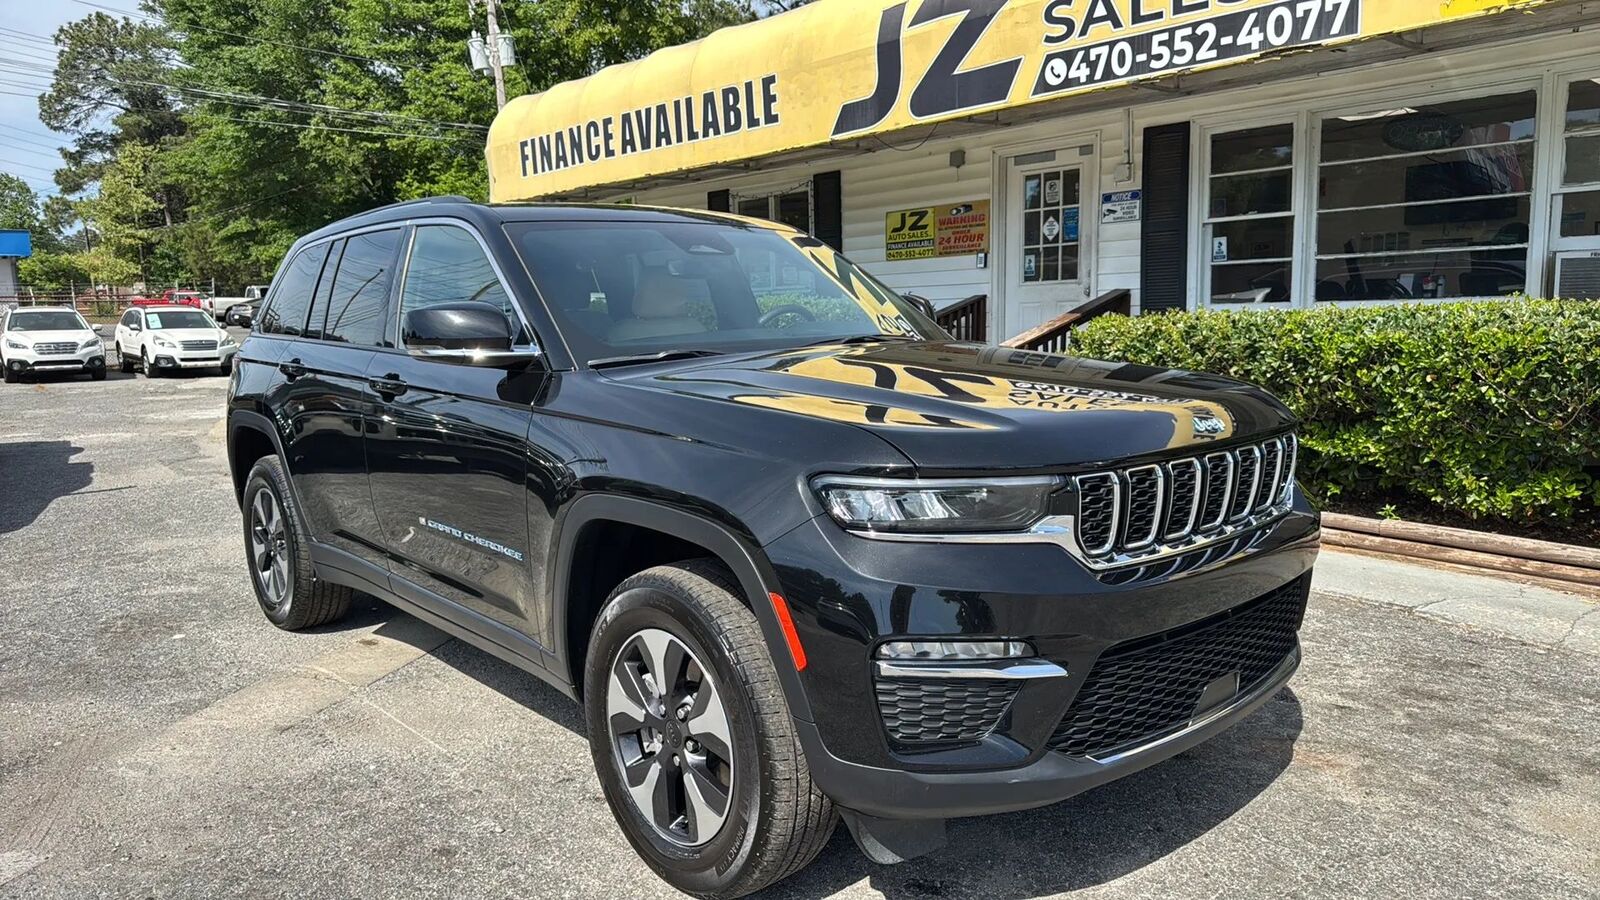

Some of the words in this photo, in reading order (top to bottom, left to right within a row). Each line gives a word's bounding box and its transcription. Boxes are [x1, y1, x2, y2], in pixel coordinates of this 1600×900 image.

[1068, 0, 1350, 82] 470-552-4077
[831, 0, 1023, 136] JZ
[520, 117, 615, 177] FINANCE
[621, 74, 779, 155] AVAILABLE
[1111, 191, 1131, 201] NOTICE
[891, 210, 928, 233] JZ
[938, 213, 985, 226] WARNING
[888, 232, 906, 241] AUTO
[907, 230, 929, 239] SALES
[938, 236, 951, 246] 24
[954, 232, 985, 243] HOUR
[888, 242, 907, 250] FINANCE
[907, 239, 933, 248] AVAILABLE
[1192, 417, 1226, 434] Jeep
[427, 519, 461, 538] GRAND
[463, 532, 523, 561] CHEROKEE
